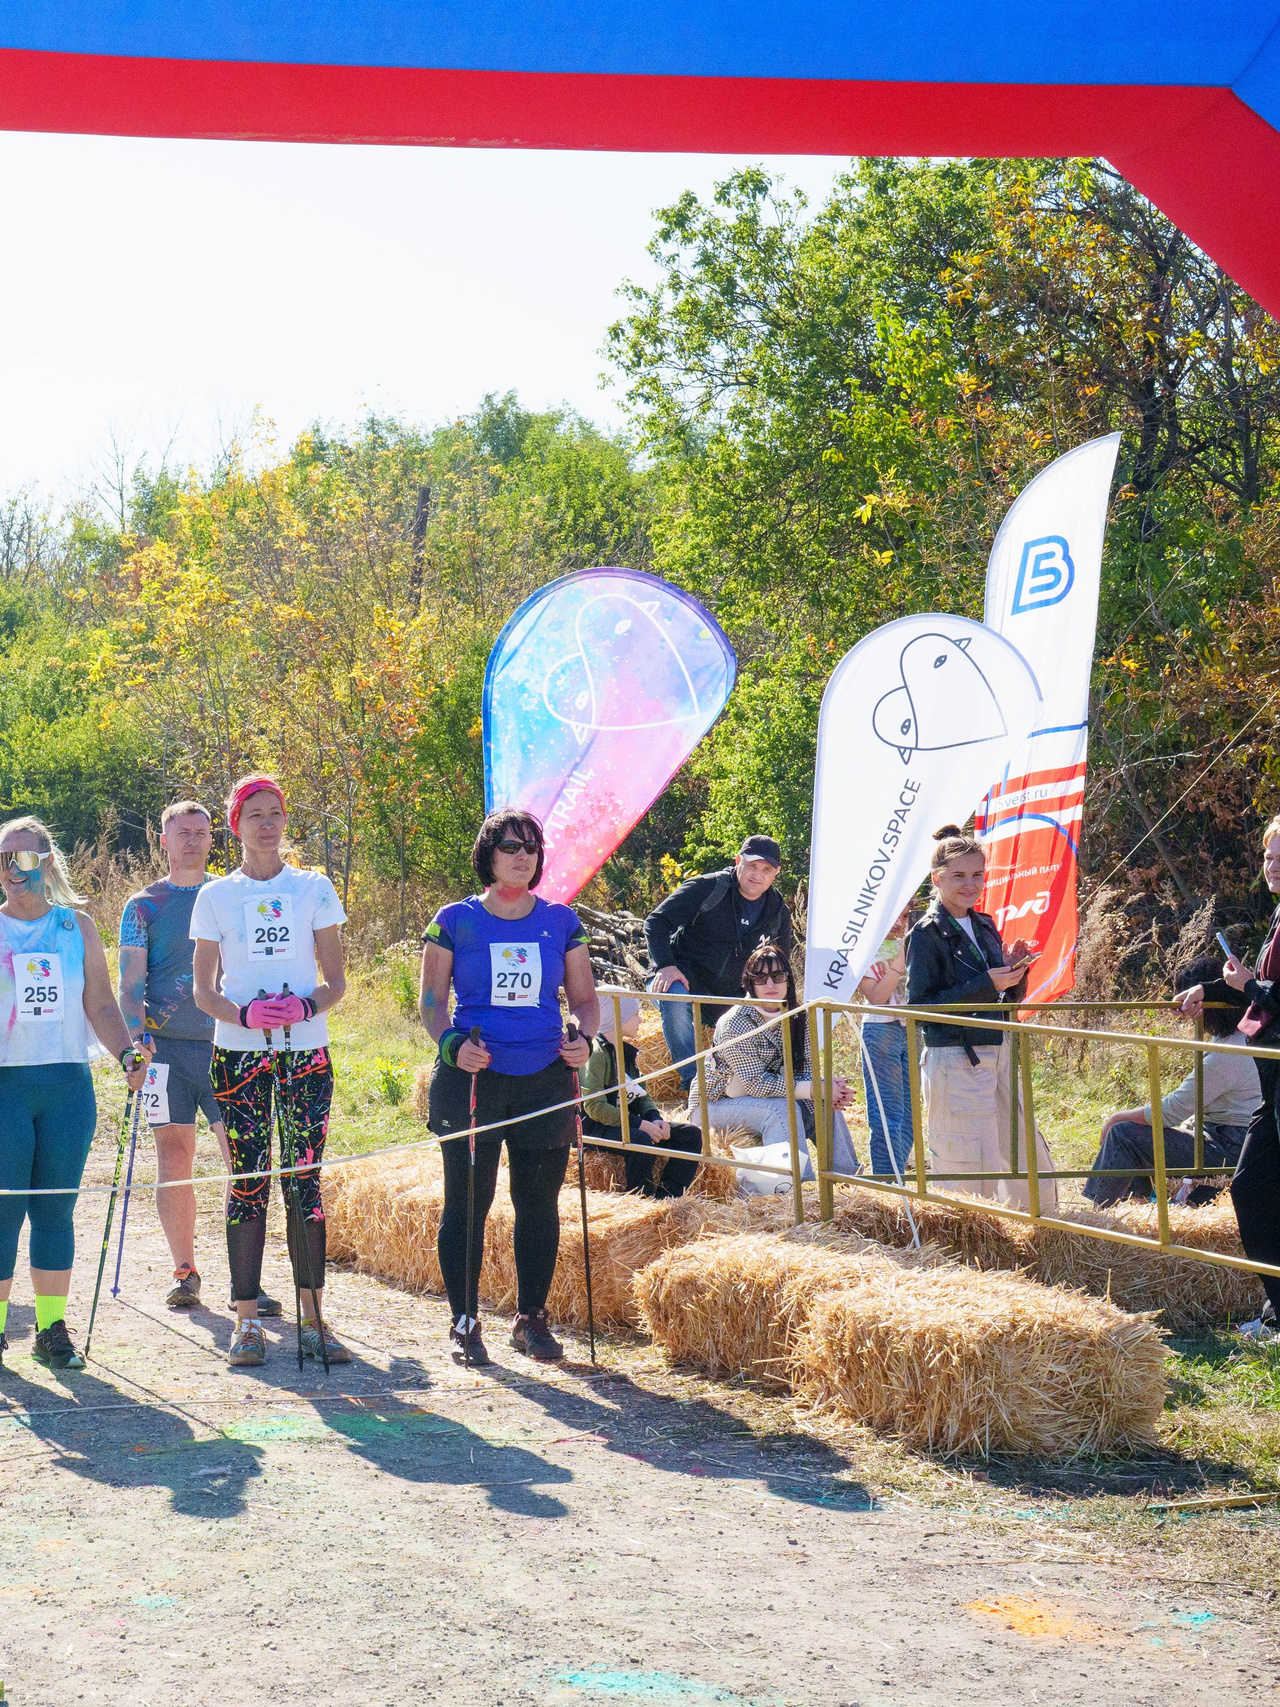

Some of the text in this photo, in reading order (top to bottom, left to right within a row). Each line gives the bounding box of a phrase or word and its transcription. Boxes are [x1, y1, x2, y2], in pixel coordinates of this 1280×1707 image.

[822, 778, 922, 991] KRASILNIKOV.SPACE
[254, 926, 290, 944] 262
[496, 972, 532, 989] 270
[24, 986, 58, 1003] 255
